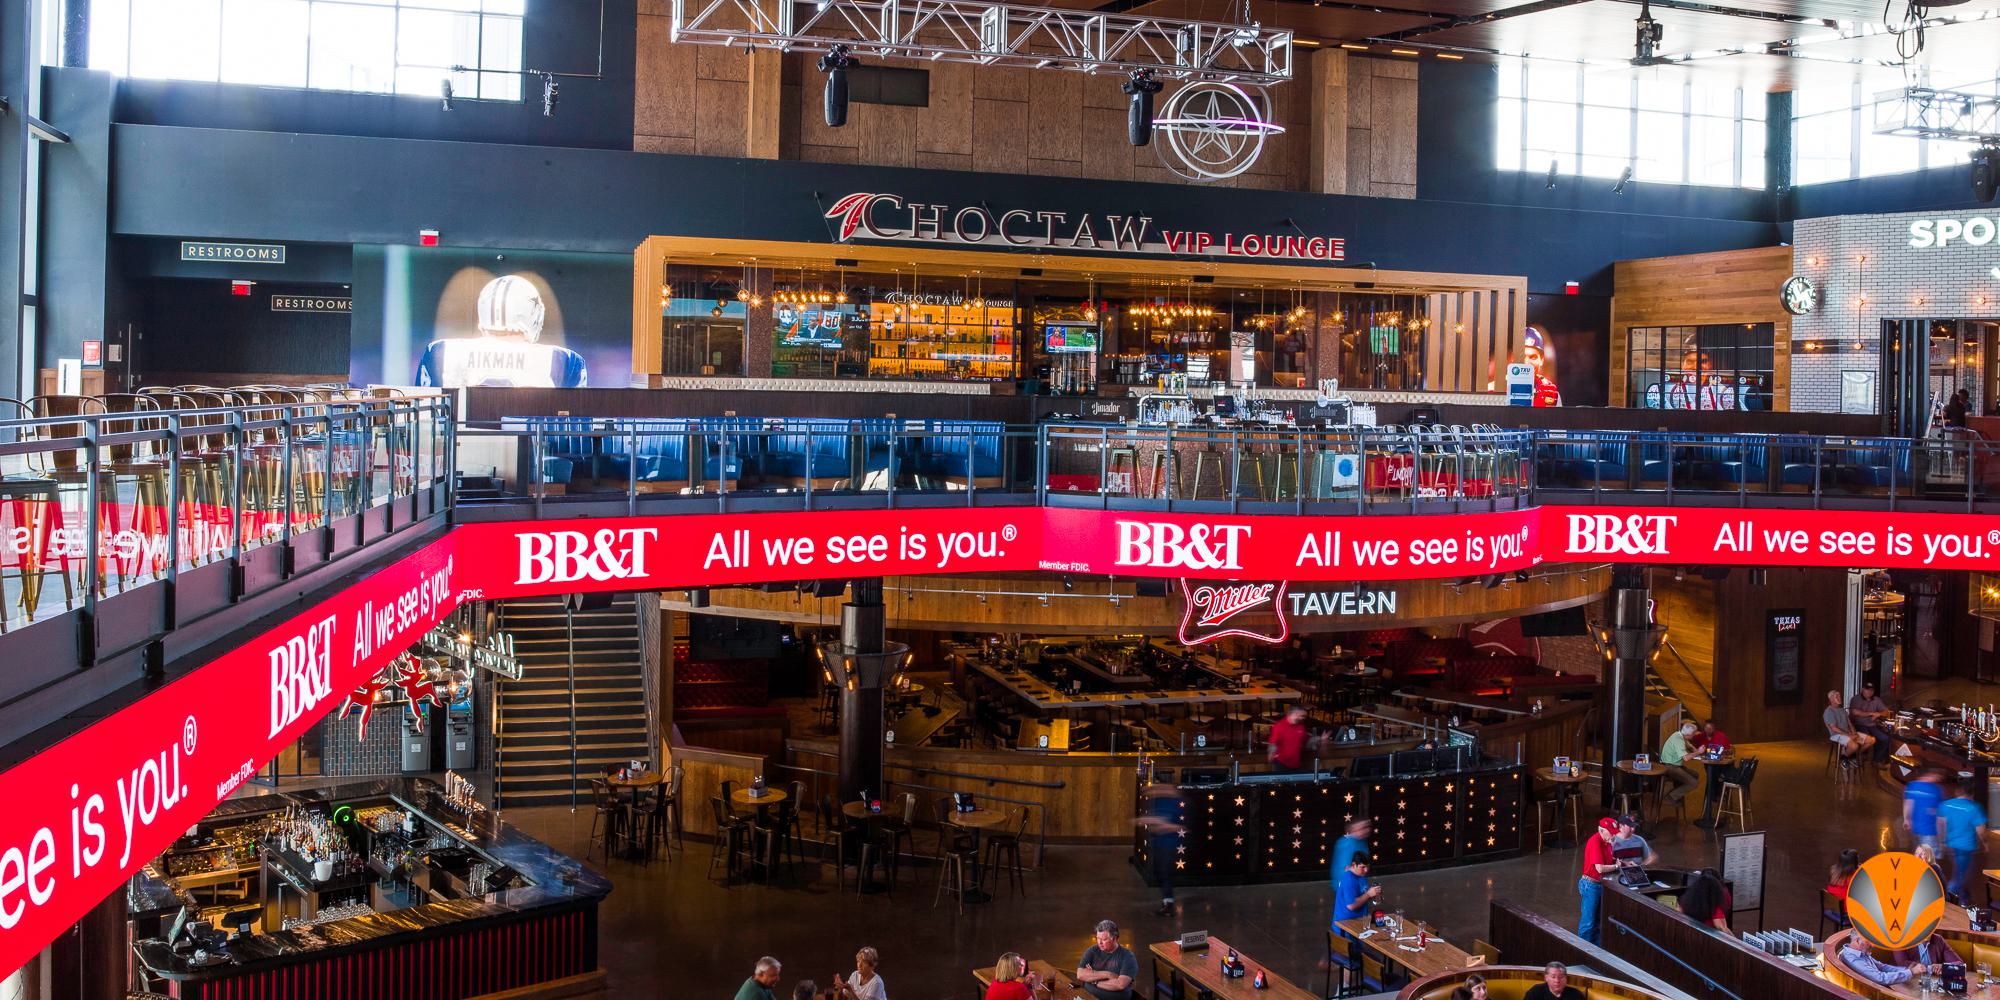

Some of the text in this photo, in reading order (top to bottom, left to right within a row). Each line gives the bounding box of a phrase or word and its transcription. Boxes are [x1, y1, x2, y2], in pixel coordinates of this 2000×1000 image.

[862, 193, 1345, 261] CHOCTAW VIP LOUNGE
[1909, 216, 2000, 248] SPO
[188, 246, 279, 259] RESTROOMS
[468, 351, 525, 369] AIKMAN
[1115, 520, 1252, 570] BB&T
[1295, 531, 1341, 567] All
[1353, 539, 1399, 566] we
[1409, 538, 1458, 565] see
[1465, 530, 1484, 562] is
[1565, 514, 1678, 555] BB&T
[1713, 521, 1753, 552] All
[1763, 529, 1809, 553] we
[1819, 530, 1876, 555] see
[1887, 526, 1912, 556] is
[514, 528, 658, 585] BB&T
[703, 529, 750, 570] All
[762, 535, 815, 566] we
[826, 533, 888, 564] see
[900, 526, 927, 561] is
[1038, 560, 1091, 573] Member FDIC.
[1193, 584, 1397, 620] Miller TAVERN
[1774, 616, 1801, 625] TEXAS
[267, 614, 336, 740] BB&T
[353, 600, 372, 667] All
[376, 606, 394, 649] we
[397, 592, 418, 634] see
[421, 571, 429, 617] is
[217, 772, 240, 801] Member
[71, 783, 106, 879] is
